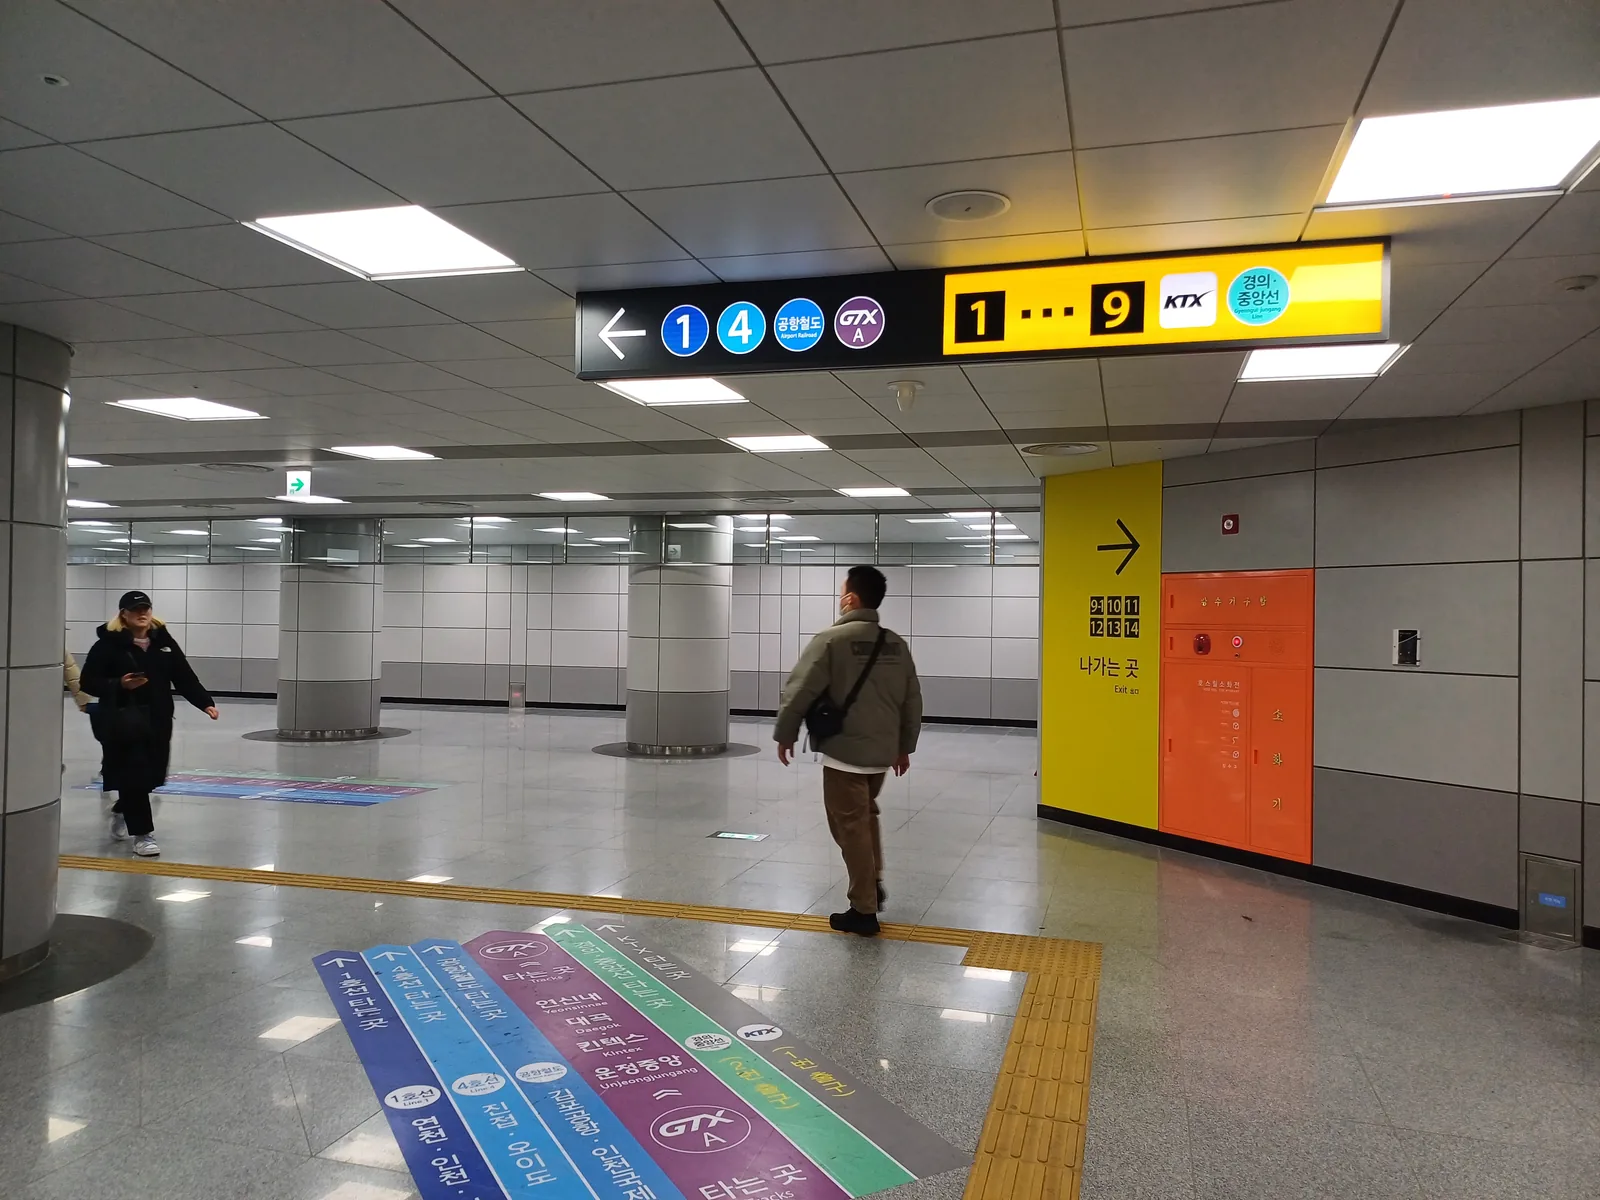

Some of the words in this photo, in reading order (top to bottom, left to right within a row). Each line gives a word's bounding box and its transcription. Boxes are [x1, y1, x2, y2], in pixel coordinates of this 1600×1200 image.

[1164, 291, 1209, 309] KTX
[1237, 290, 1279, 307] 중앙선
[840, 309, 878, 326] GTX
[970, 300, 986, 336] 1
[1103, 290, 1131, 329] 9
[676, 314, 690, 349] 1
[728, 309, 753, 345] 4
[778, 315, 822, 331] 공항철도
[781, 332, 797, 340] Airport
[853, 328, 865, 343] A
[1090, 599, 1104, 613] 9-1
[1107, 599, 1121, 613] 10
[1125, 599, 1139, 613] 11
[1090, 621, 1104, 635] 12
[1107, 621, 1121, 635] 13
[1125, 621, 1139, 636] 14
[1079, 656, 1121, 677] 나가는
[1125, 658, 1140, 678] 곳
[1114, 685, 1128, 695] Exit
[1272, 709, 1284, 811] 소화기
[485, 941, 538, 954] GTX
[502, 970, 548, 981] 타는
[552, 965, 575, 975] 곳
[643, 955, 678, 971] 타는
[665, 969, 692, 980] 곳
[338, 972, 370, 996] 1호선
[391, 966, 424, 989] 4호선
[530, 975, 563, 984] Tracks
[404, 989, 438, 1009] 타는
[464, 990, 498, 1009] 타는
[536, 992, 603, 1009] 연신내
[623, 980, 660, 999] 타는
[646, 998, 673, 1009] 곳
[348, 997, 381, 1018] 타는
[479, 1009, 508, 1021] 곳
[543, 1001, 608, 1014] Yeonsinnae
[358, 1017, 388, 1031] 곳
[418, 1010, 447, 1024] 곳
[565, 1012, 613, 1026] 대곡
[575, 1022, 622, 1034] Daegok
[744, 1026, 776, 1038] KTX
[576, 1033, 649, 1053] 킨텍스
[602, 1047, 643, 1058] Kintex
[519, 1066, 564, 1078] 공항철도
[594, 1055, 683, 1081] 운정중앙
[458, 1074, 500, 1090] 4호선
[600, 1067, 698, 1090] Unjeongjungang
[391, 1088, 435, 1103] 1호선
[659, 1109, 734, 1137] GTX
[703, 1132, 727, 1147] A
[698, 1177, 769, 1200] 타는
[769, 1164, 807, 1185] 곳
